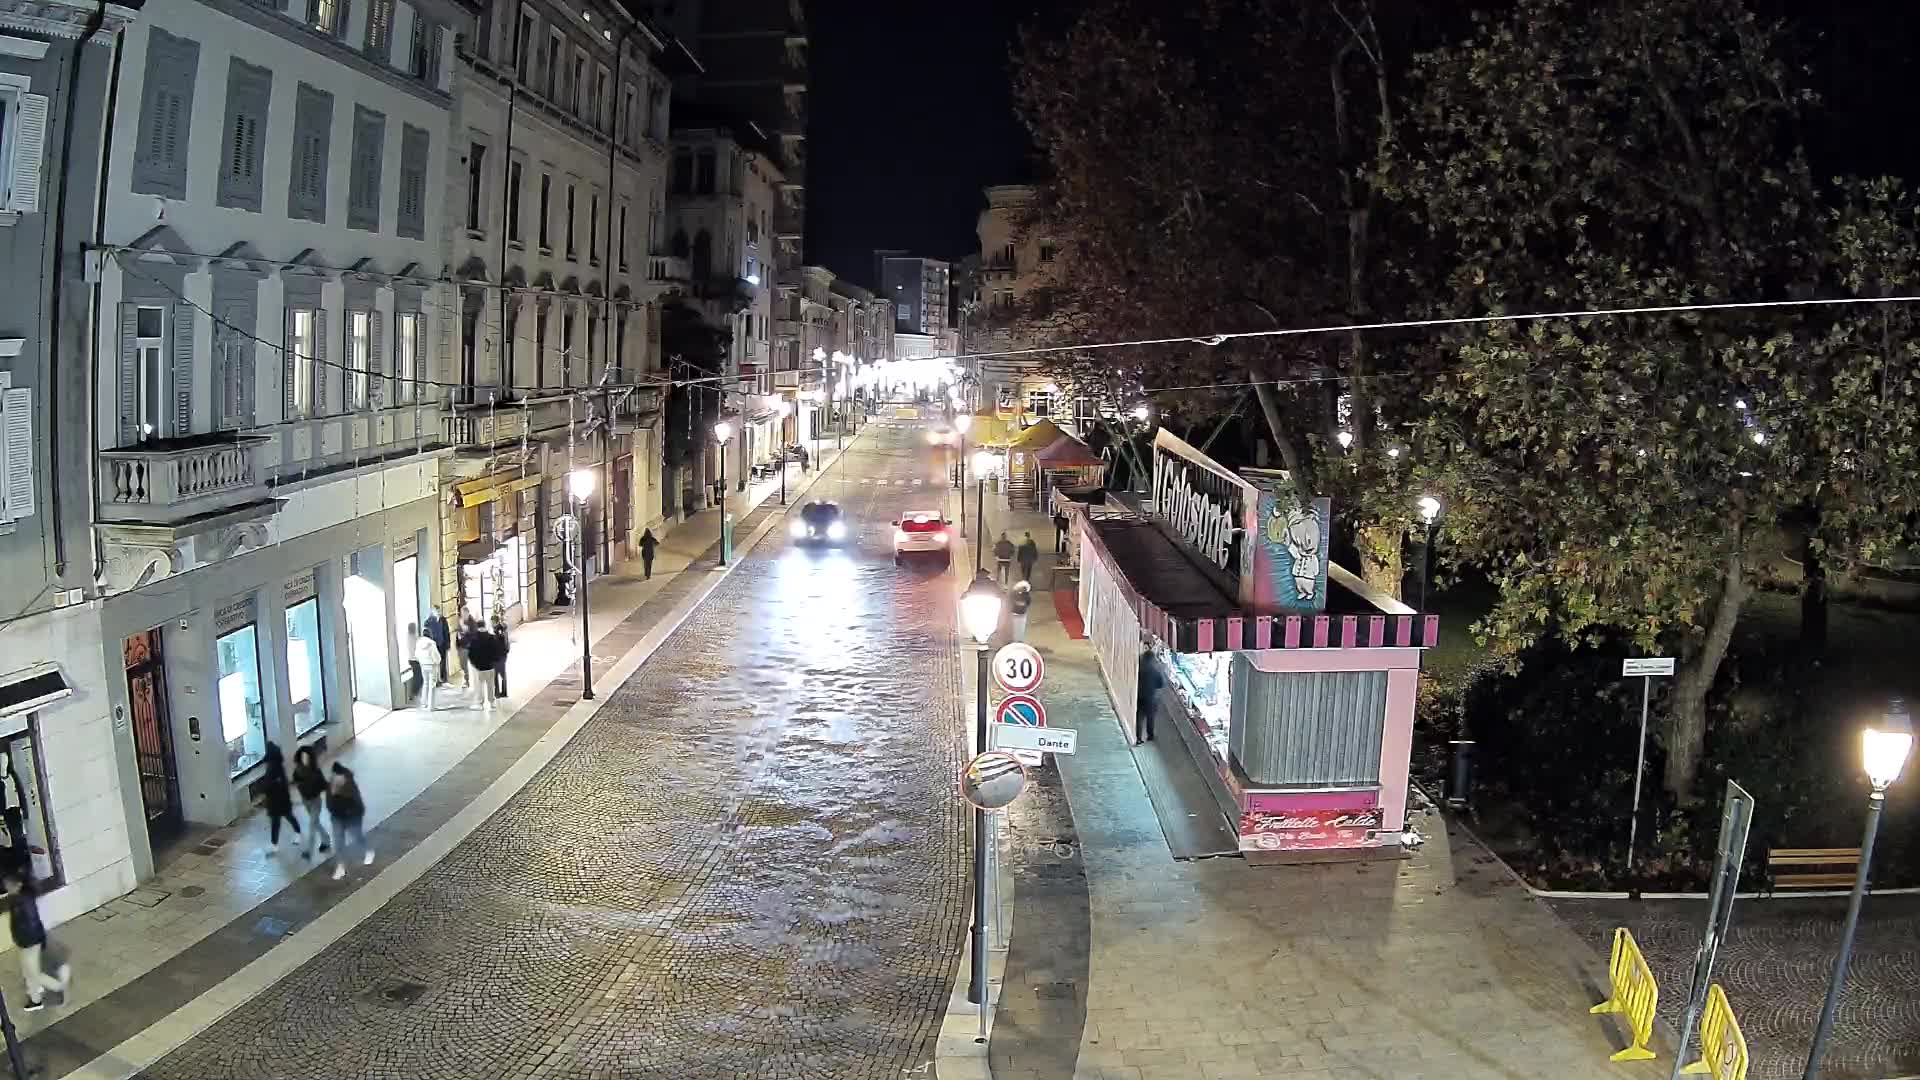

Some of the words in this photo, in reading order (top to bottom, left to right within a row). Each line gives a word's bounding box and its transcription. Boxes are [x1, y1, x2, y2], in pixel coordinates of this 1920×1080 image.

[1163, 458, 1233, 570] Golosone
[1006, 658, 1032, 679] 30
[1038, 737, 1069, 749] Dante
